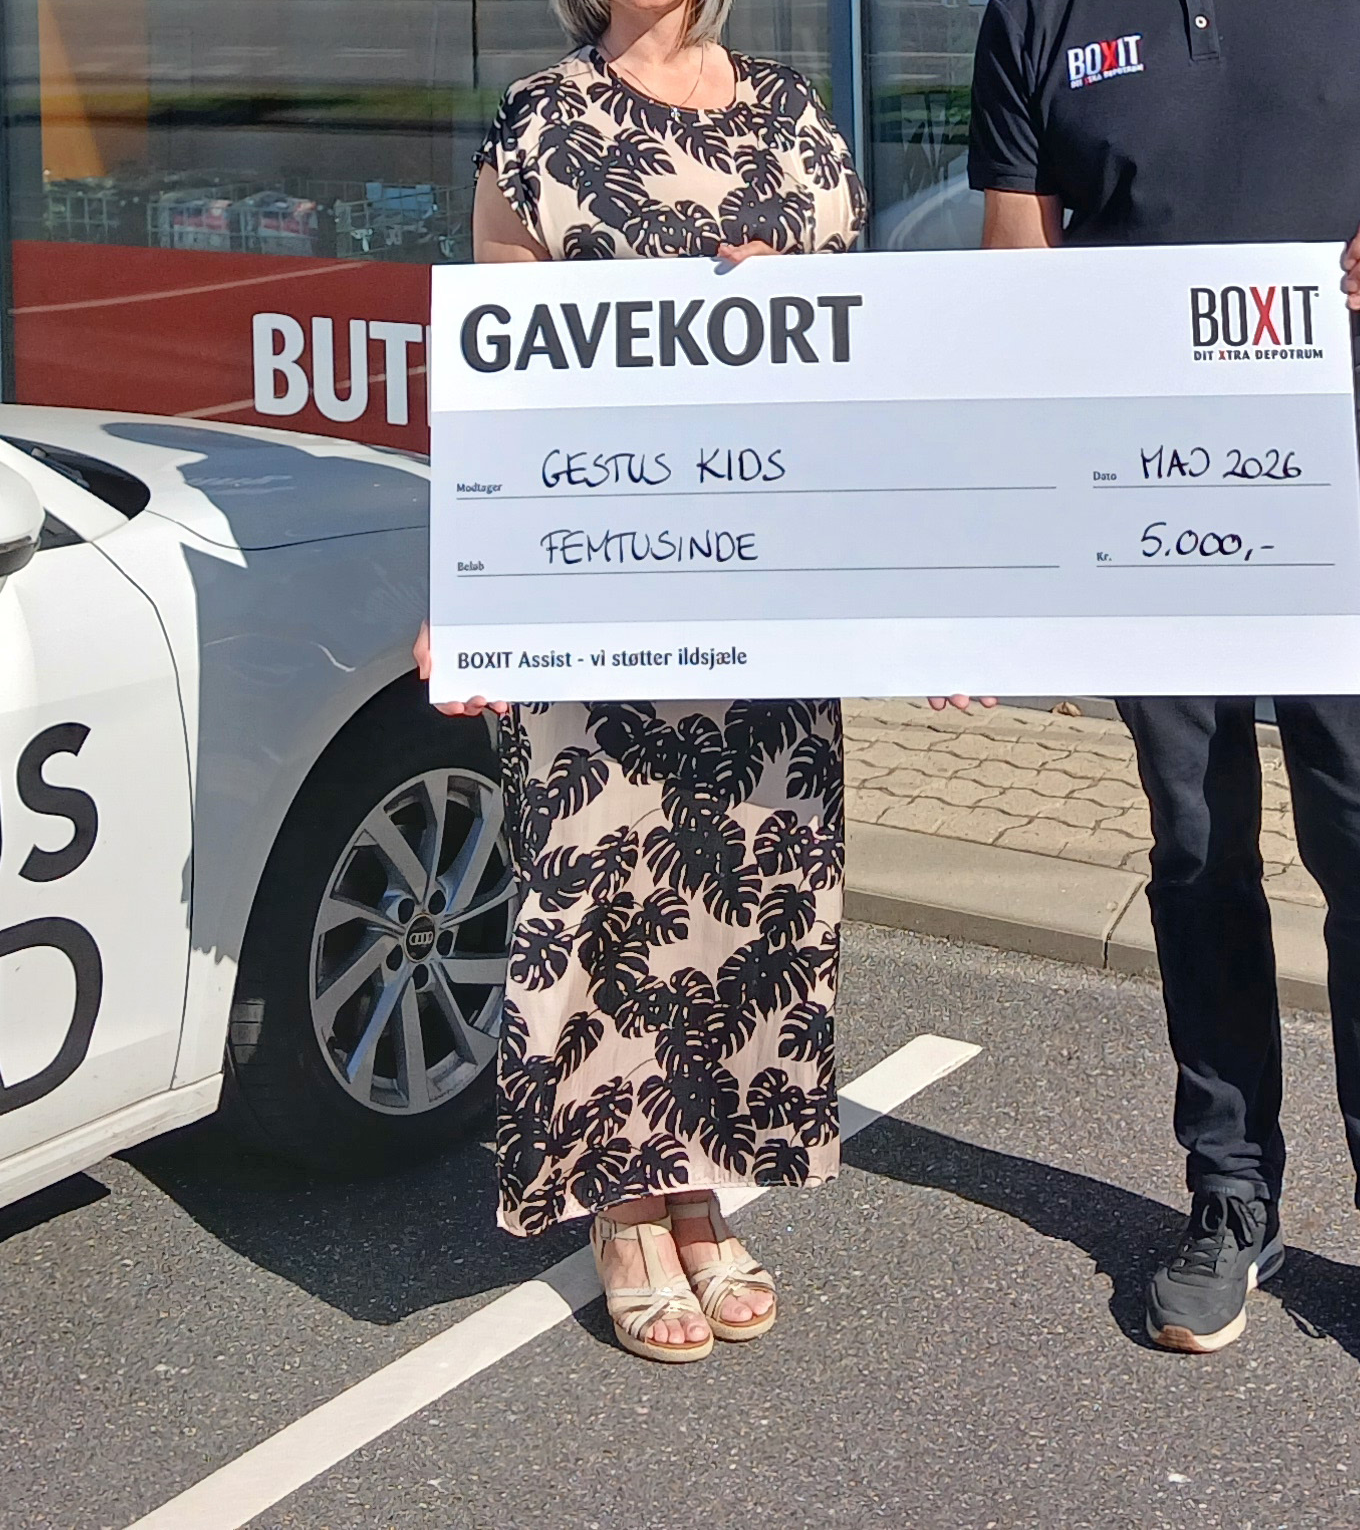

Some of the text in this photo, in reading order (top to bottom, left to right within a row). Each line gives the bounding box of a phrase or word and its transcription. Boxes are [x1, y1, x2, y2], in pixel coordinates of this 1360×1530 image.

[1067, 35, 1141, 81] BOXIT
[459, 294, 863, 374] GAVEKORT
[1189, 285, 1320, 347] BOXIT
[251, 312, 432, 427] BUT
[1193, 348, 1324, 361] DIT XTRA DEPOTRUM
[541, 447, 786, 489] GESTUS KIDS
[1092, 470, 1118, 481] Dato
[1140, 444, 1303, 480] MAJ 2026
[456, 480, 503, 495] Modtager
[539, 529, 760, 565] FEMTUSINDE
[1096, 552, 1113, 562] Kr.
[1140, 522, 1275, 561] 5.000,-
[457, 651, 514, 670] BOXIT
[518, 650, 573, 669] Assist
[590, 649, 607, 667] vi
[611, 648, 673, 667] støtter
[678, 646, 749, 671] ildsjæle
